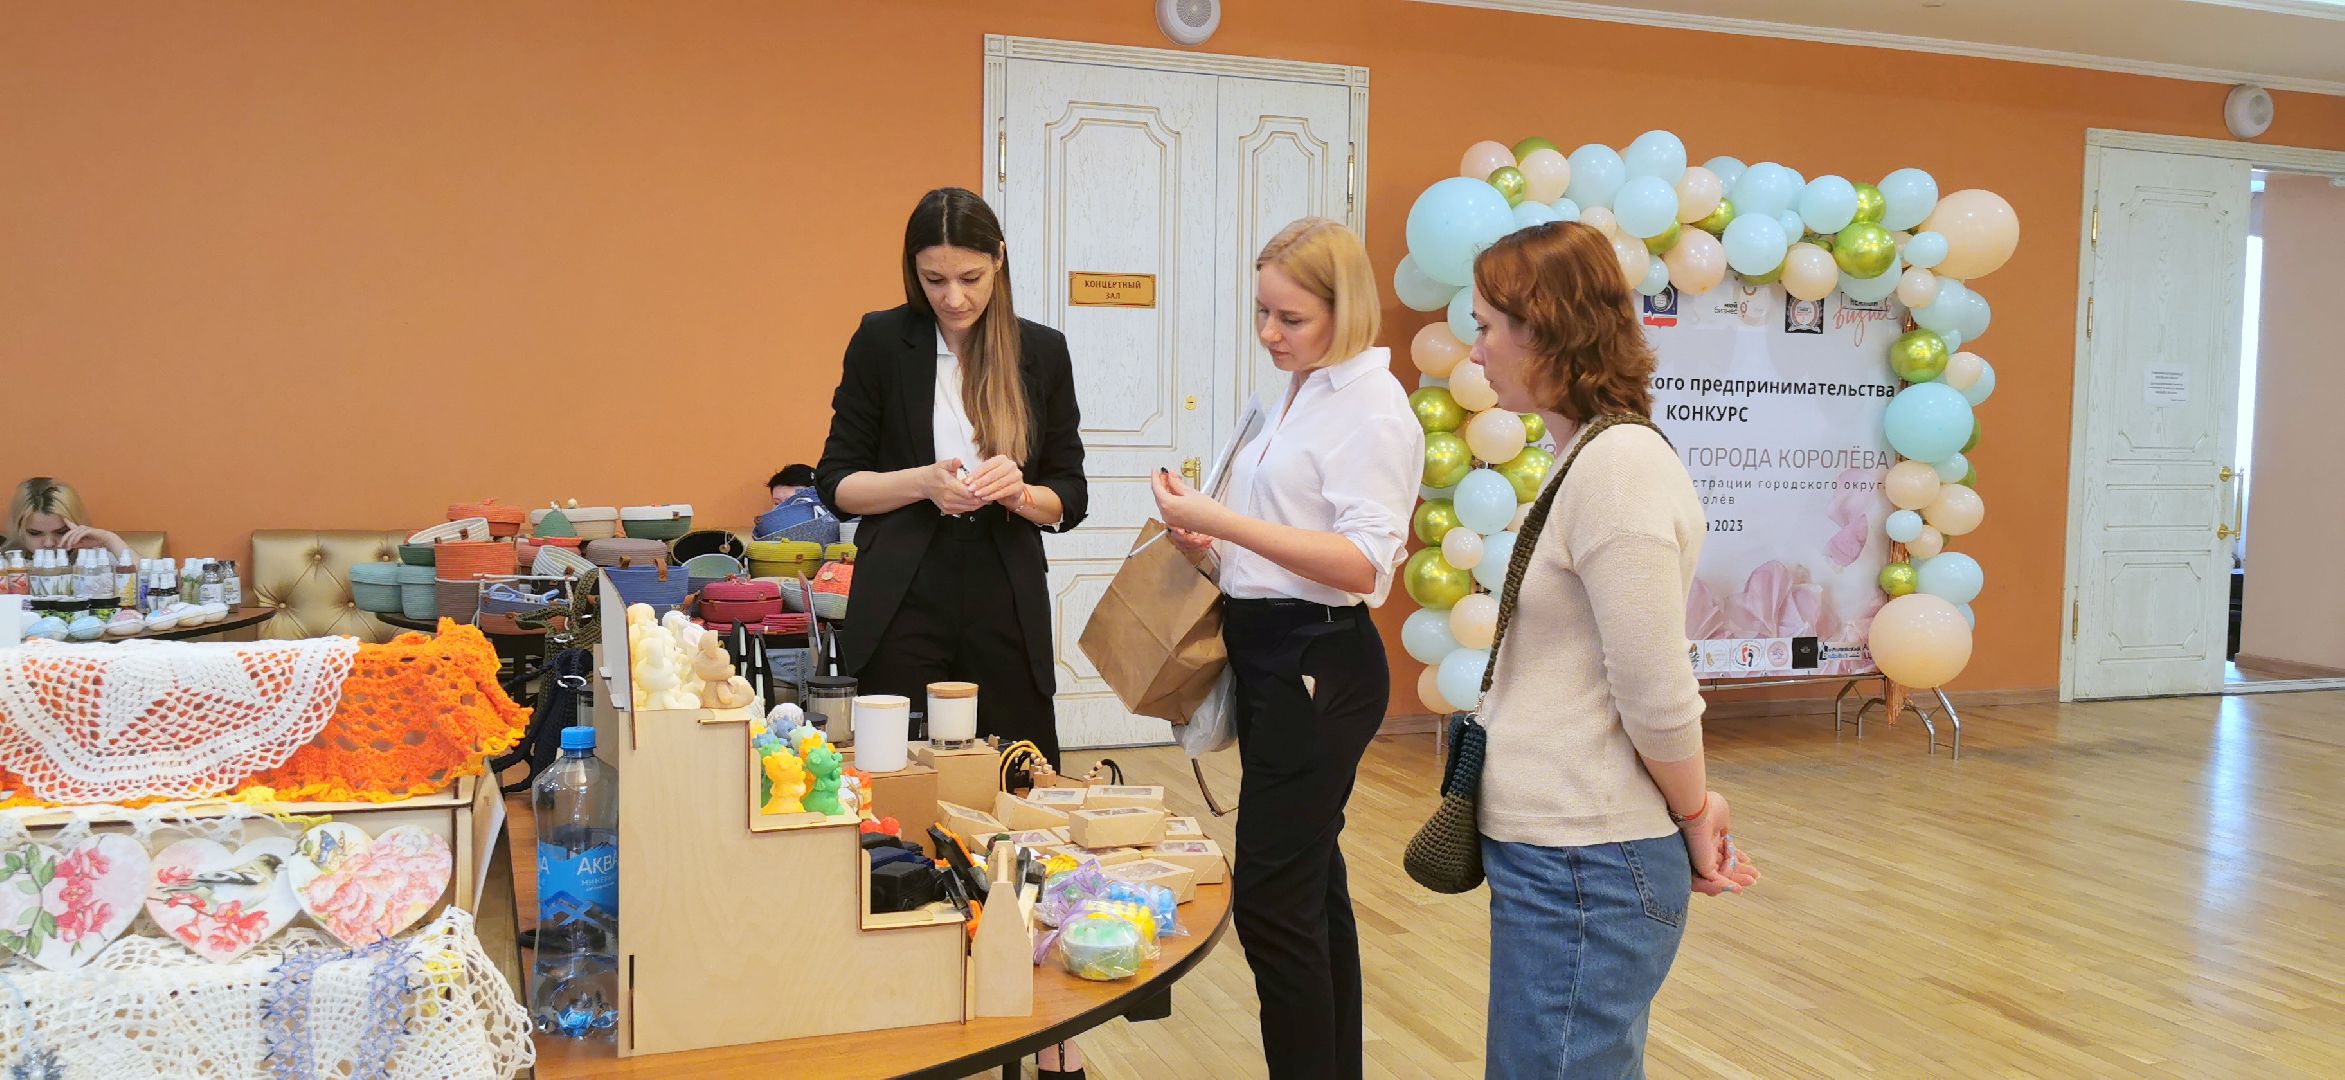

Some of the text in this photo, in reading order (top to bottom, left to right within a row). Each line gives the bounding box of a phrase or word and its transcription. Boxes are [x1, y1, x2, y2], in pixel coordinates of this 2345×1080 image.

[1084, 279, 1142, 289] КОНЦЕРТНЫЙ
[1105, 292, 1121, 300] ЗАЛ
[1652, 377, 1895, 398] ого предпринимательства
[1666, 404, 1750, 423] КОНКУРС
[1688, 447, 1772, 471] ГОРОДА
[1778, 445, 1890, 470] КОРОЛЁВА
[1758, 480, 1838, 491] городского
[1844, 481, 1886, 492] округ
[1698, 493, 1735, 505] олёв
[1714, 519, 1744, 532] 2023
